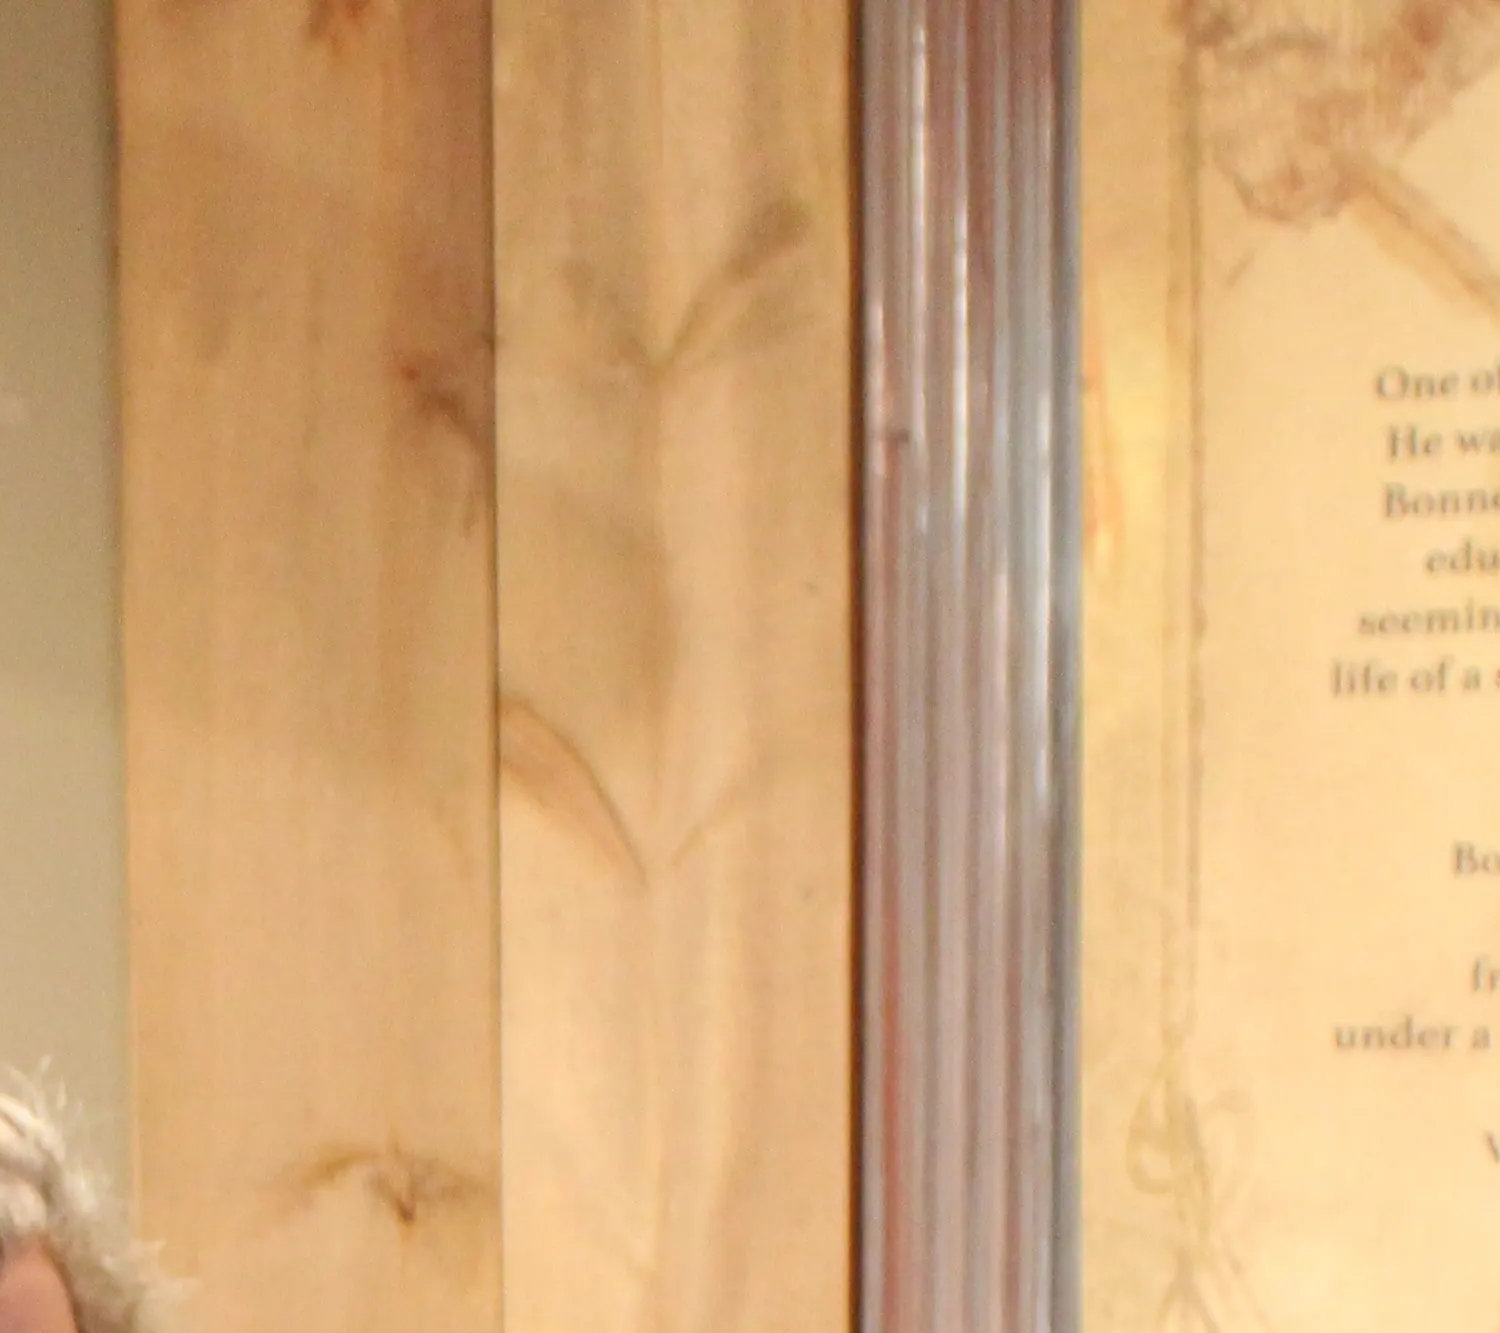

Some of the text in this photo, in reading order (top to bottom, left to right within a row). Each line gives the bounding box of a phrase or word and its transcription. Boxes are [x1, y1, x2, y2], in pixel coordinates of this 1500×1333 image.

[1374, 367, 1459, 400] One
[1387, 424, 1443, 462] He
[1331, 660, 1398, 697] life
[1408, 656, 1453, 694] of
[1333, 1014, 1456, 1052] under
